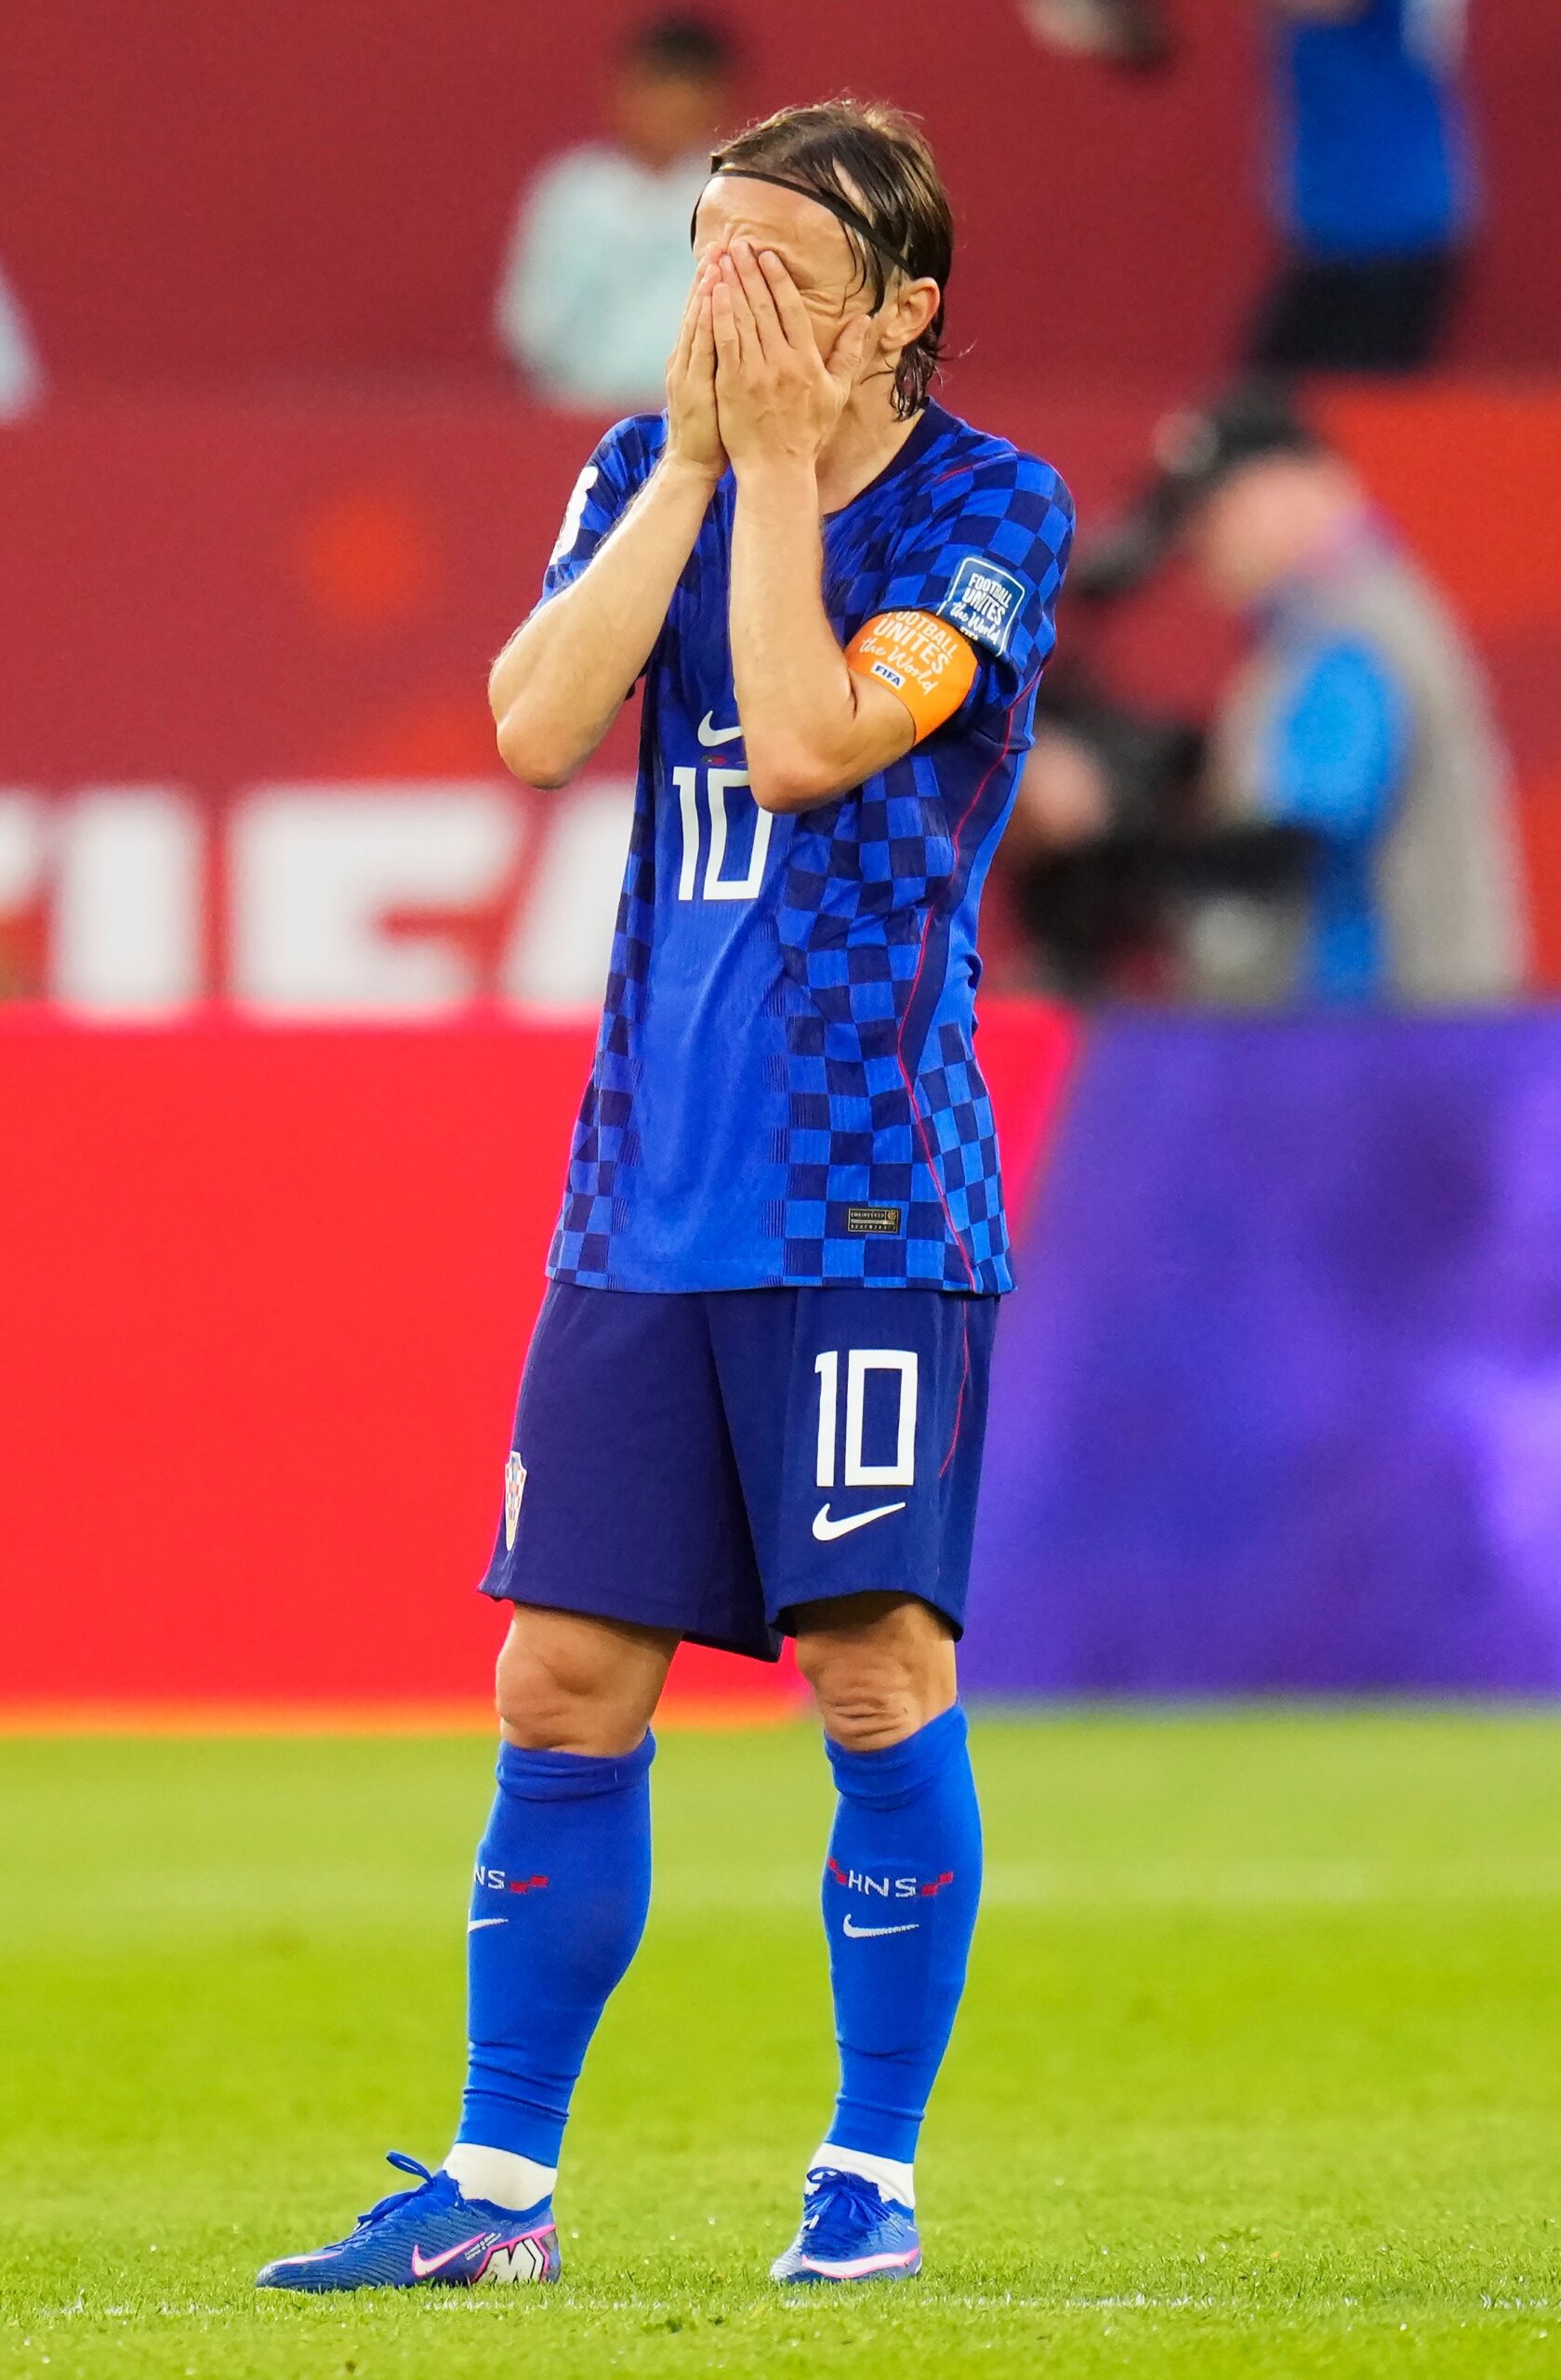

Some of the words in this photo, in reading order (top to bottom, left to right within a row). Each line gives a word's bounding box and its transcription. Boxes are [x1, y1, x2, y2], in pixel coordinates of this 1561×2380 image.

[961, 587, 1006, 626] UNITES
[967, 611, 1001, 645] World
[859, 637, 886, 656] the
[887, 645, 939, 696] World
[872, 617, 949, 675] UNITES
[875, 665, 901, 687] FIFA
[672, 766, 774, 901] 10
[814, 1349, 918, 1488] 10
[848, 1870, 917, 1897] HNS
